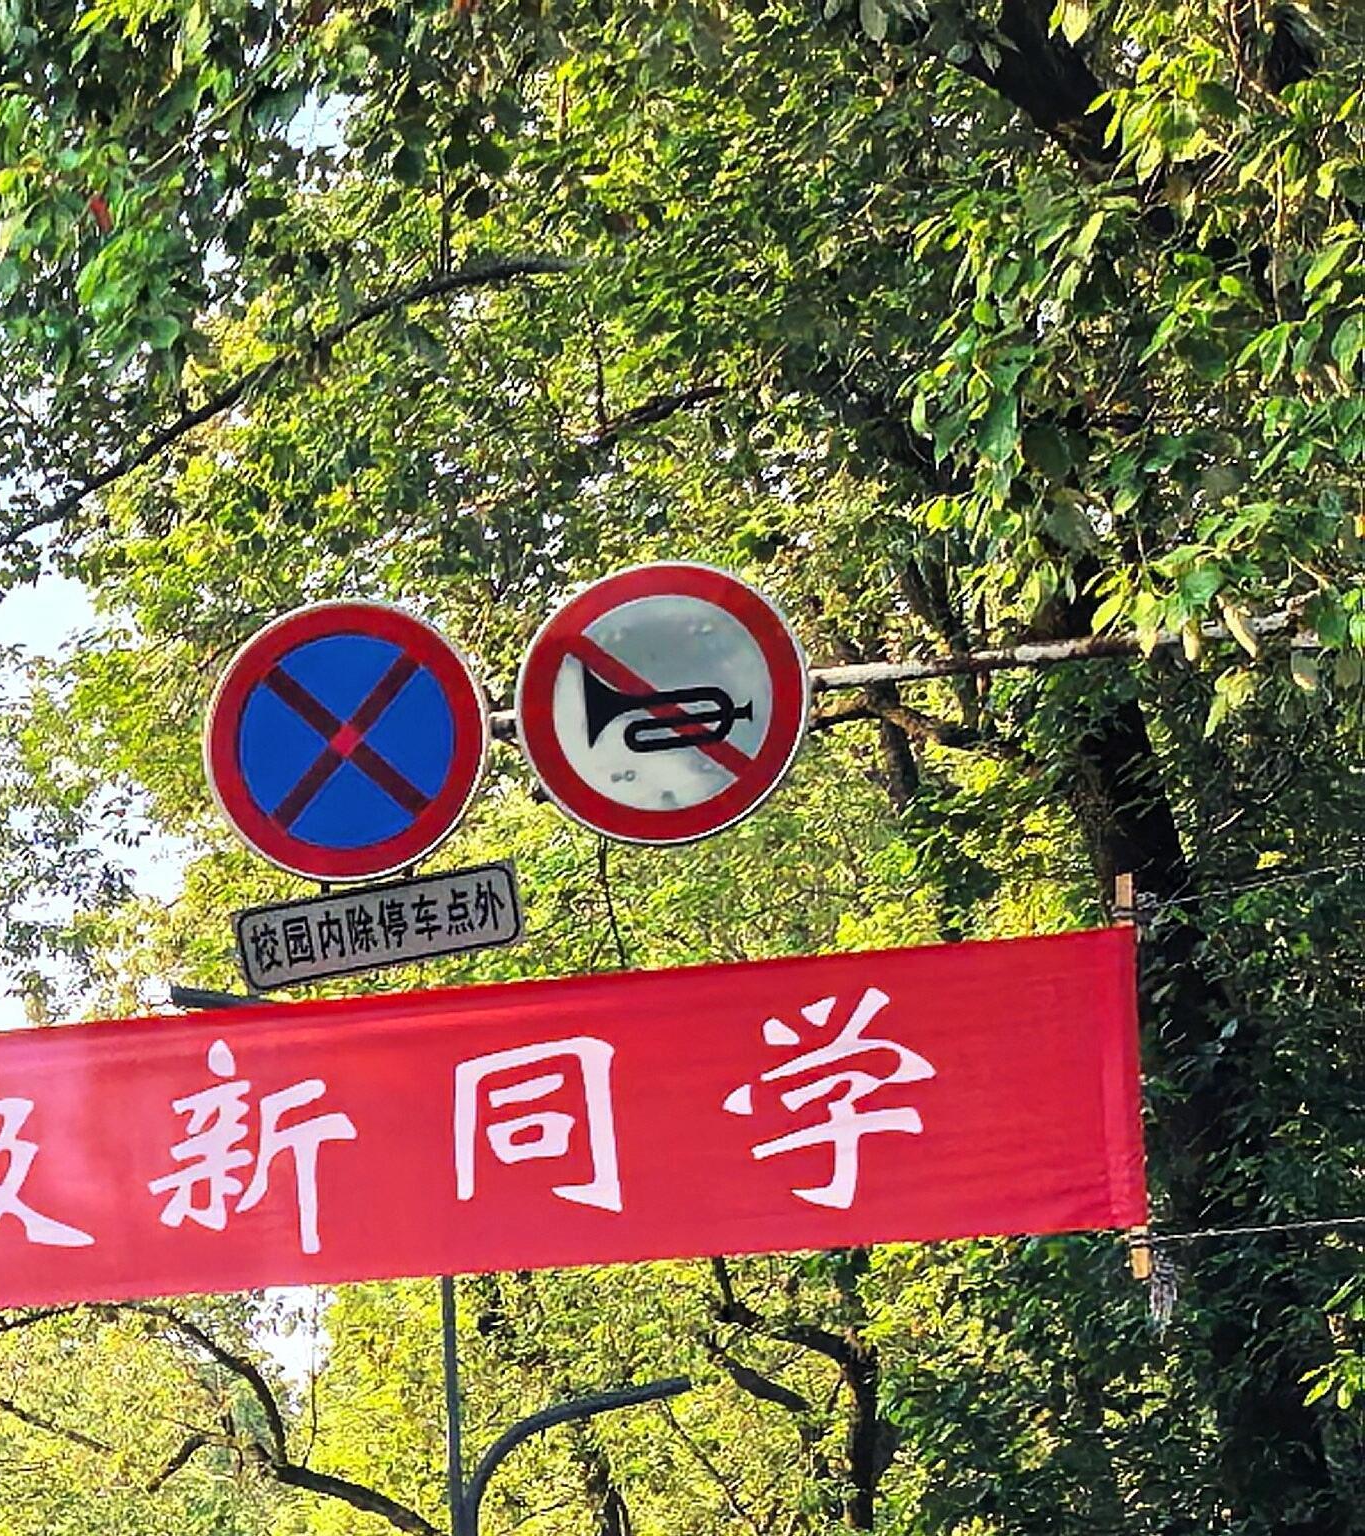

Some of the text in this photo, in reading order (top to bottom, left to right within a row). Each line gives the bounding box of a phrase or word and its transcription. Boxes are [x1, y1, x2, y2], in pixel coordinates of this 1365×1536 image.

[250, 879, 505, 974] 校园内除停车点外
